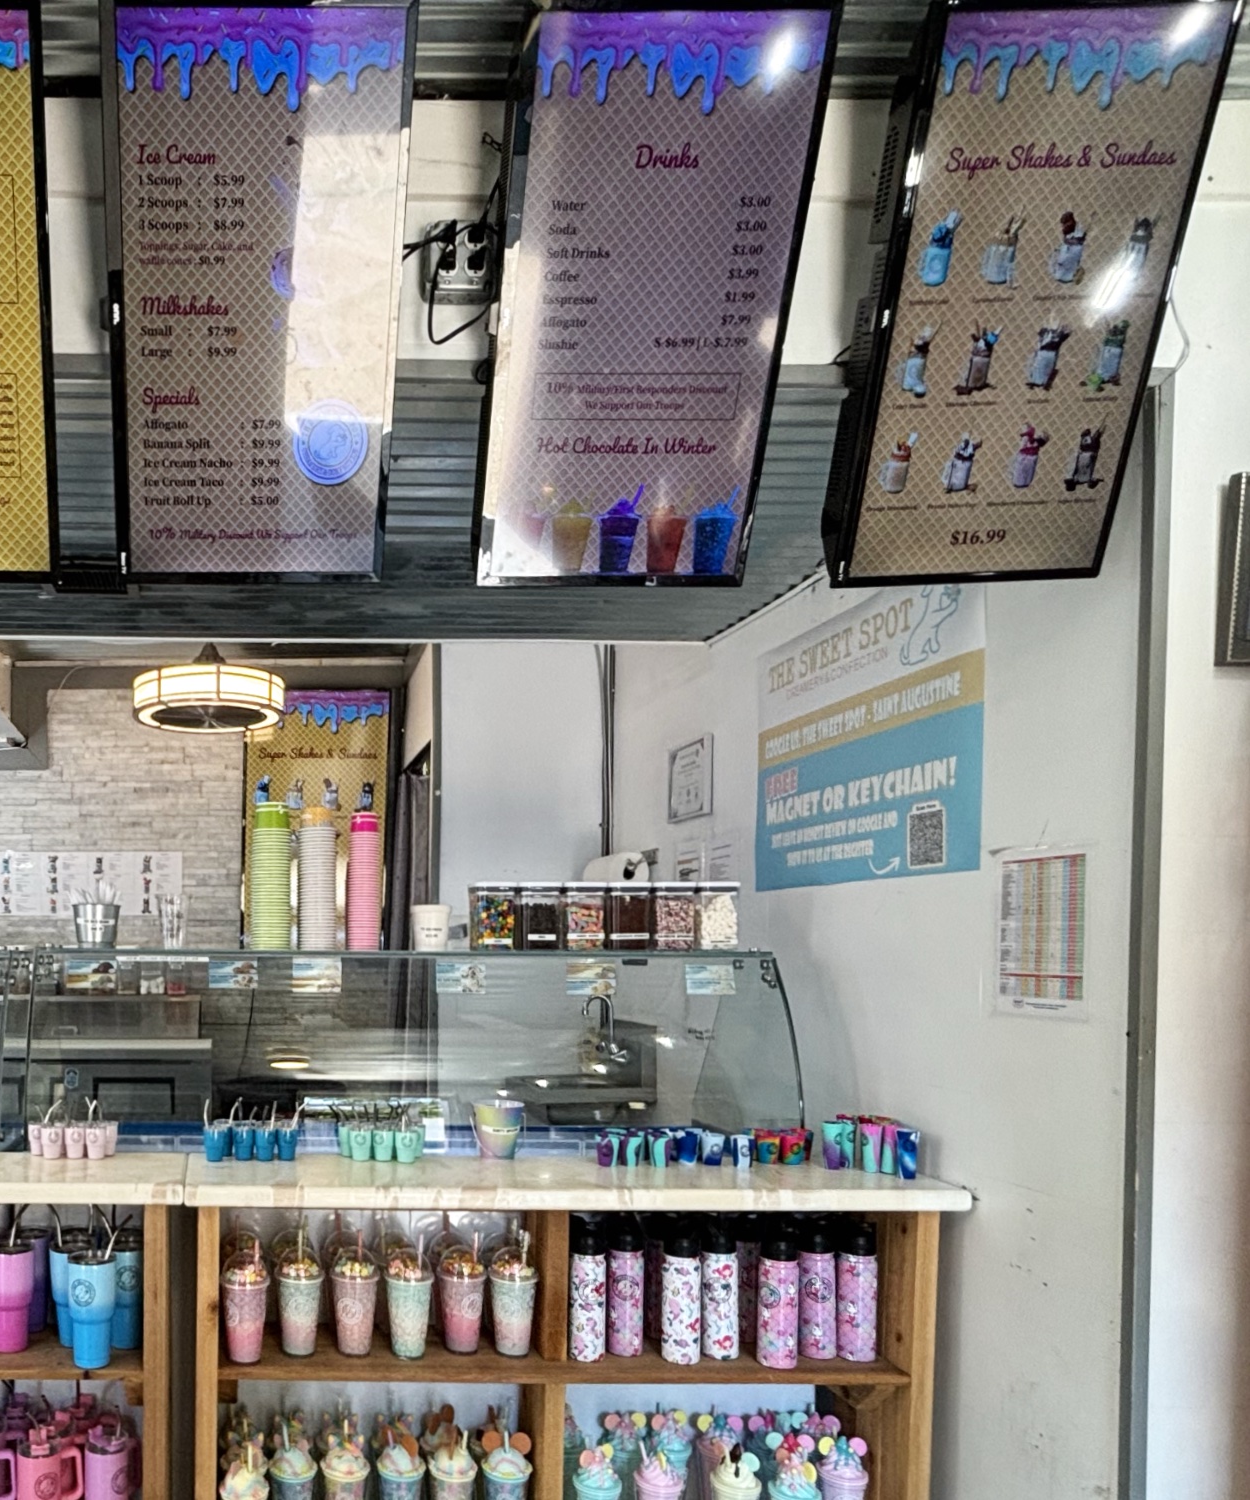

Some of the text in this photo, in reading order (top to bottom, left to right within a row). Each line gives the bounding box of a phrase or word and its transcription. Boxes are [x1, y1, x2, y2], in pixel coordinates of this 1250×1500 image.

[136, 144, 216, 165] Ice Cream
[636, 142, 699, 169] Drinks
[945, 140, 1177, 180] Super Shakes & Sundaes
[138, 175, 245, 188] 1 Scoop $5.99
[138, 197, 244, 211] 2 Scoops $7.99
[552, 196, 771, 212] Water $3.00
[139, 220, 244, 233] 3 Scoops $8.99
[549, 220, 767, 235] Soda $3.00
[547, 244, 763, 259] Soft Drinks $3.00
[199, 256, 225, 266] $0.99
[544, 268, 759, 282] Coffee $3.99
[724, 291, 755, 303] $1.99
[141, 295, 229, 316] Milkshakes
[541, 314, 751, 330] Affogato $7.99
[140, 325, 237, 337] Small $7.99
[538, 339, 578, 350] Slushie
[141, 346, 237, 360] Large $9.99
[547, 382, 573, 394] 10%
[637, 384, 687, 397] Responders
[689, 384, 727, 394] Discount
[142, 386, 200, 413] Specials
[585, 401, 598, 409] We
[599, 401, 634, 412] Support
[654, 401, 685, 411] Troops
[143, 419, 281, 431] Affogato $7.99
[143, 438, 281, 452] Banana Split $9.99
[536, 435, 717, 454] Hot Chocolate In Winter
[143, 458, 280, 469] Ice Cream Nacho $9.99
[144, 477, 280, 488] Ice Cream Taco $9.99
[144, 495, 279, 509] Fruit Roll Up $5.00
[149, 527, 176, 540] 10%
[179, 529, 216, 543] Military
[218, 529, 253, 540] Discount
[274, 529, 308, 543] Support
[950, 529, 1006, 546] $16.99
[769, 598, 913, 694] THE SWEET SPOT
[817, 713, 844, 743] SWEET
[845, 705, 866, 732] SPOT
[873, 692, 899, 722] SAINT
[900, 671, 961, 714] AUGUSTINE
[258, 747, 286, 762] Super
[290, 747, 324, 759] Shakes
[338, 747, 378, 760] Sundaes
[765, 767, 798, 800] FREE
[766, 756, 957, 826] MAGNET OR KEYCHAIN!
